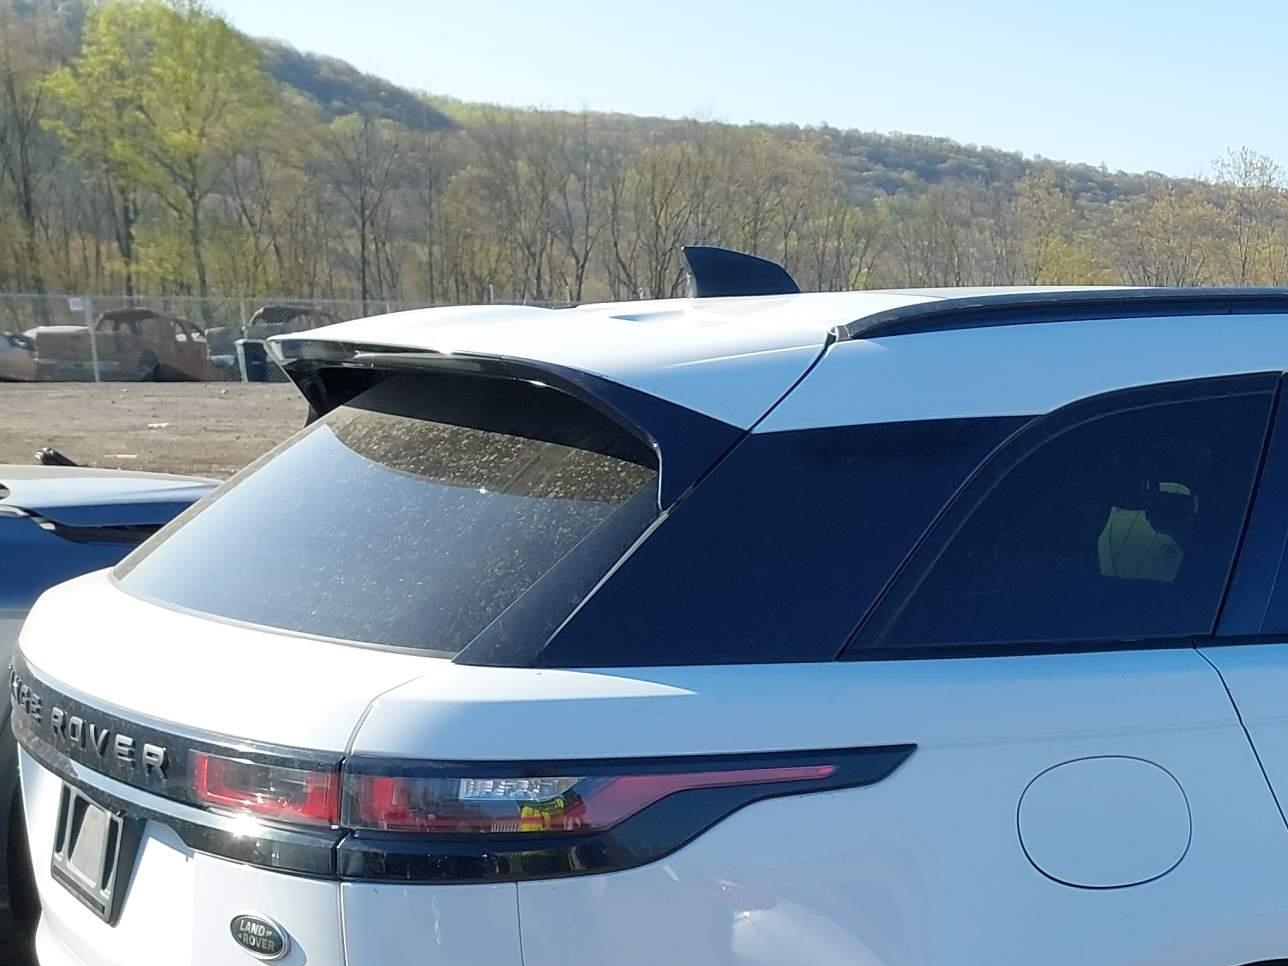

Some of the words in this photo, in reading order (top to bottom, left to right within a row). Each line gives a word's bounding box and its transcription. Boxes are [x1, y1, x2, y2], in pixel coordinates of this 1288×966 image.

[51, 706, 168, 779] ROVER
[240, 919, 265, 937] LAND
[242, 933, 275, 951] ROVER
